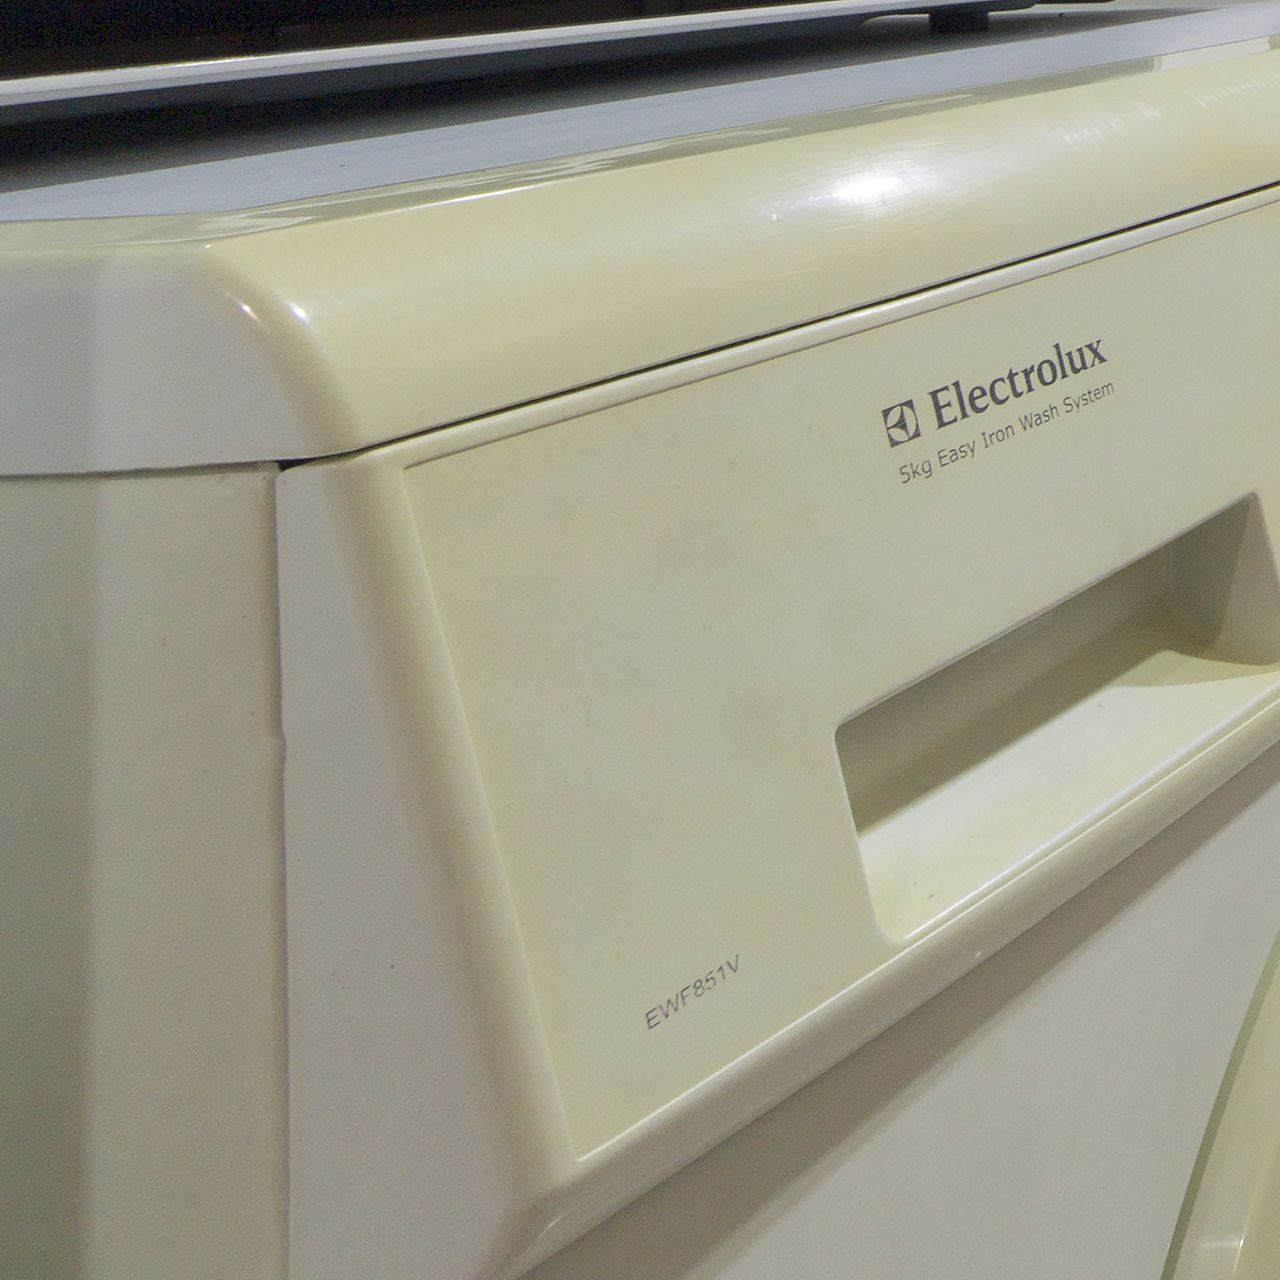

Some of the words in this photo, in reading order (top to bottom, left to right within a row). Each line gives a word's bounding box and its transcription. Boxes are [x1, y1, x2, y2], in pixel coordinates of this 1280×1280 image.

[927, 338, 1108, 430] Electrolux
[899, 459, 933, 484] 5kg
[937, 440, 976, 467] Easy
[980, 424, 1016, 449] Iron
[1017, 403, 1060, 431] Wash
[1063, 381, 1116, 414] System
[645, 952, 740, 1030] EWF851V
